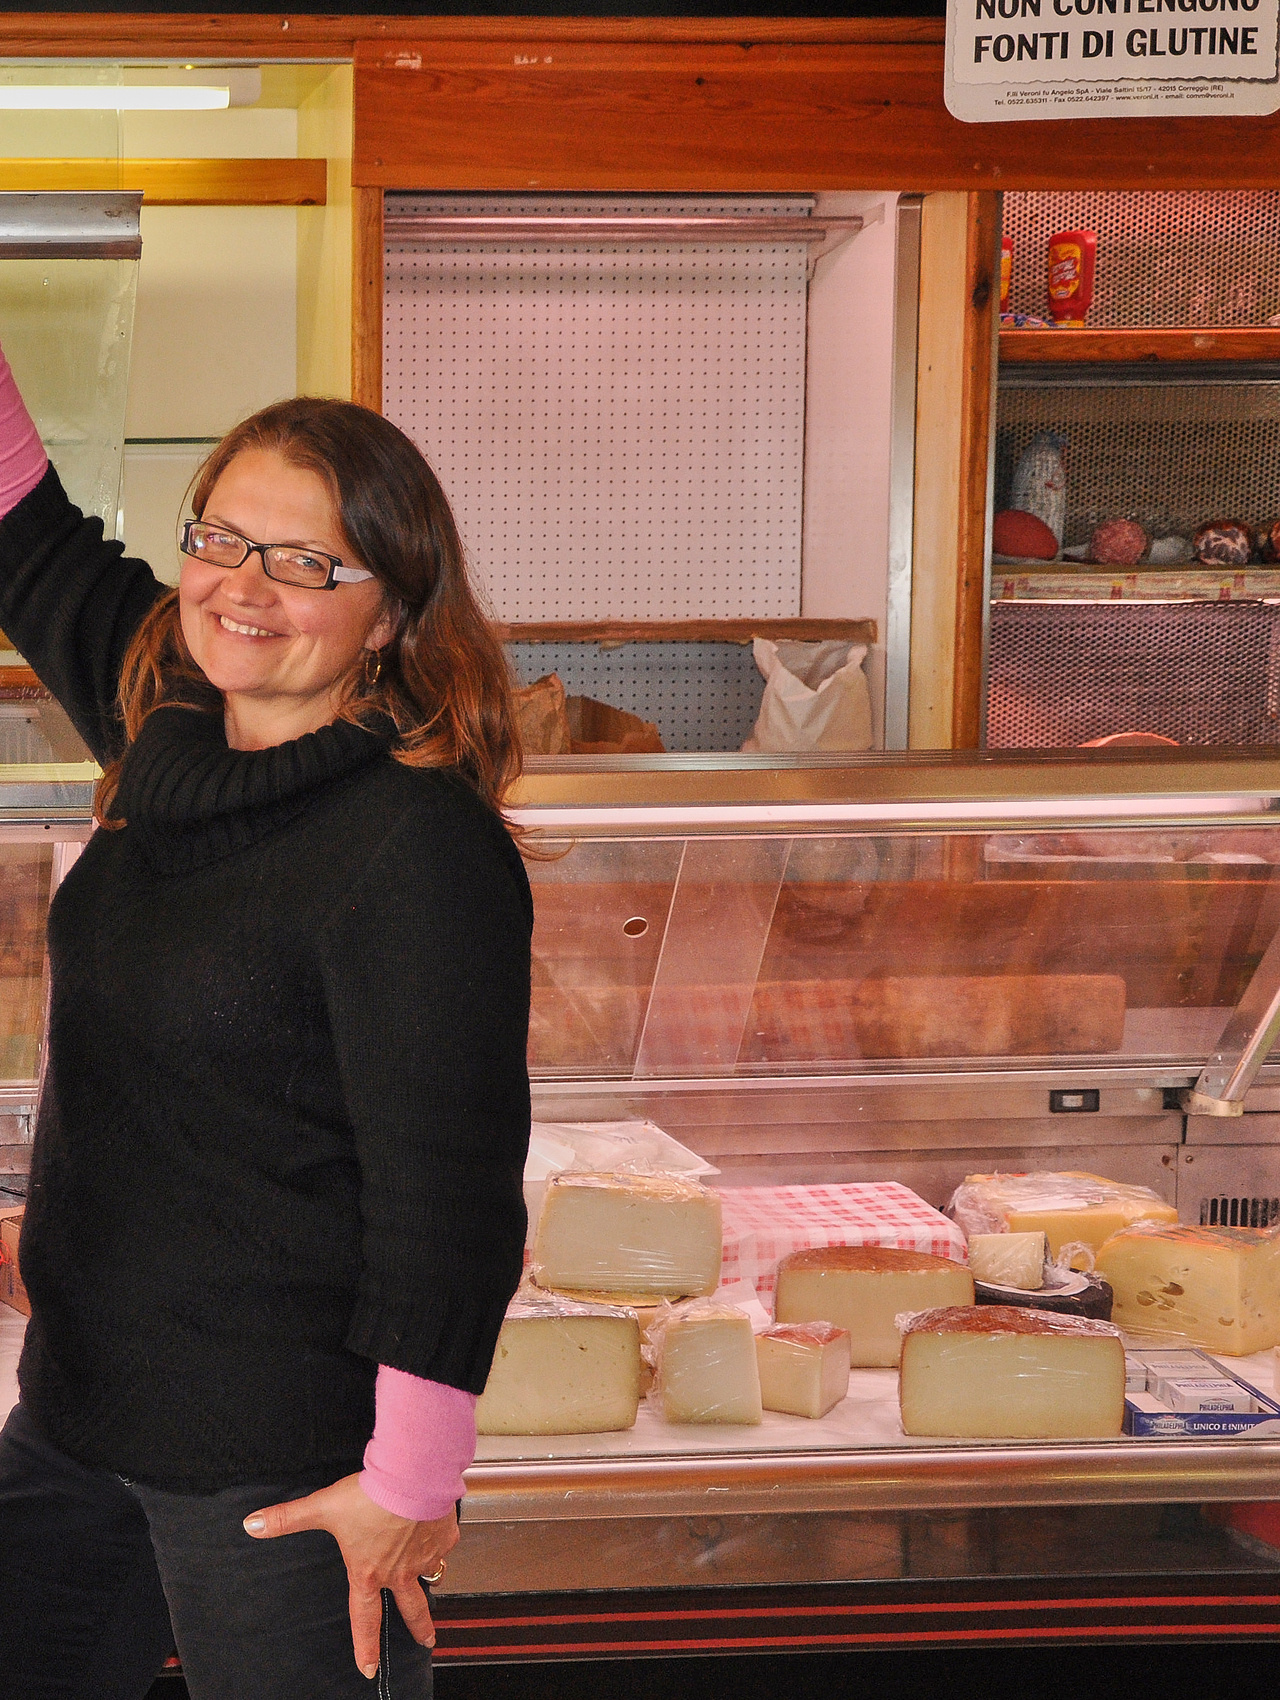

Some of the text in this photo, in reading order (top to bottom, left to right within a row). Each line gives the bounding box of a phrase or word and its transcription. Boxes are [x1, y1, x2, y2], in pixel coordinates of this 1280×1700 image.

[975, 0, 1042, 20] NON
[974, 27, 1259, 62] FONTI DI GLUTINE
[1199, 1404, 1234, 1412] PHILADELPHIA
